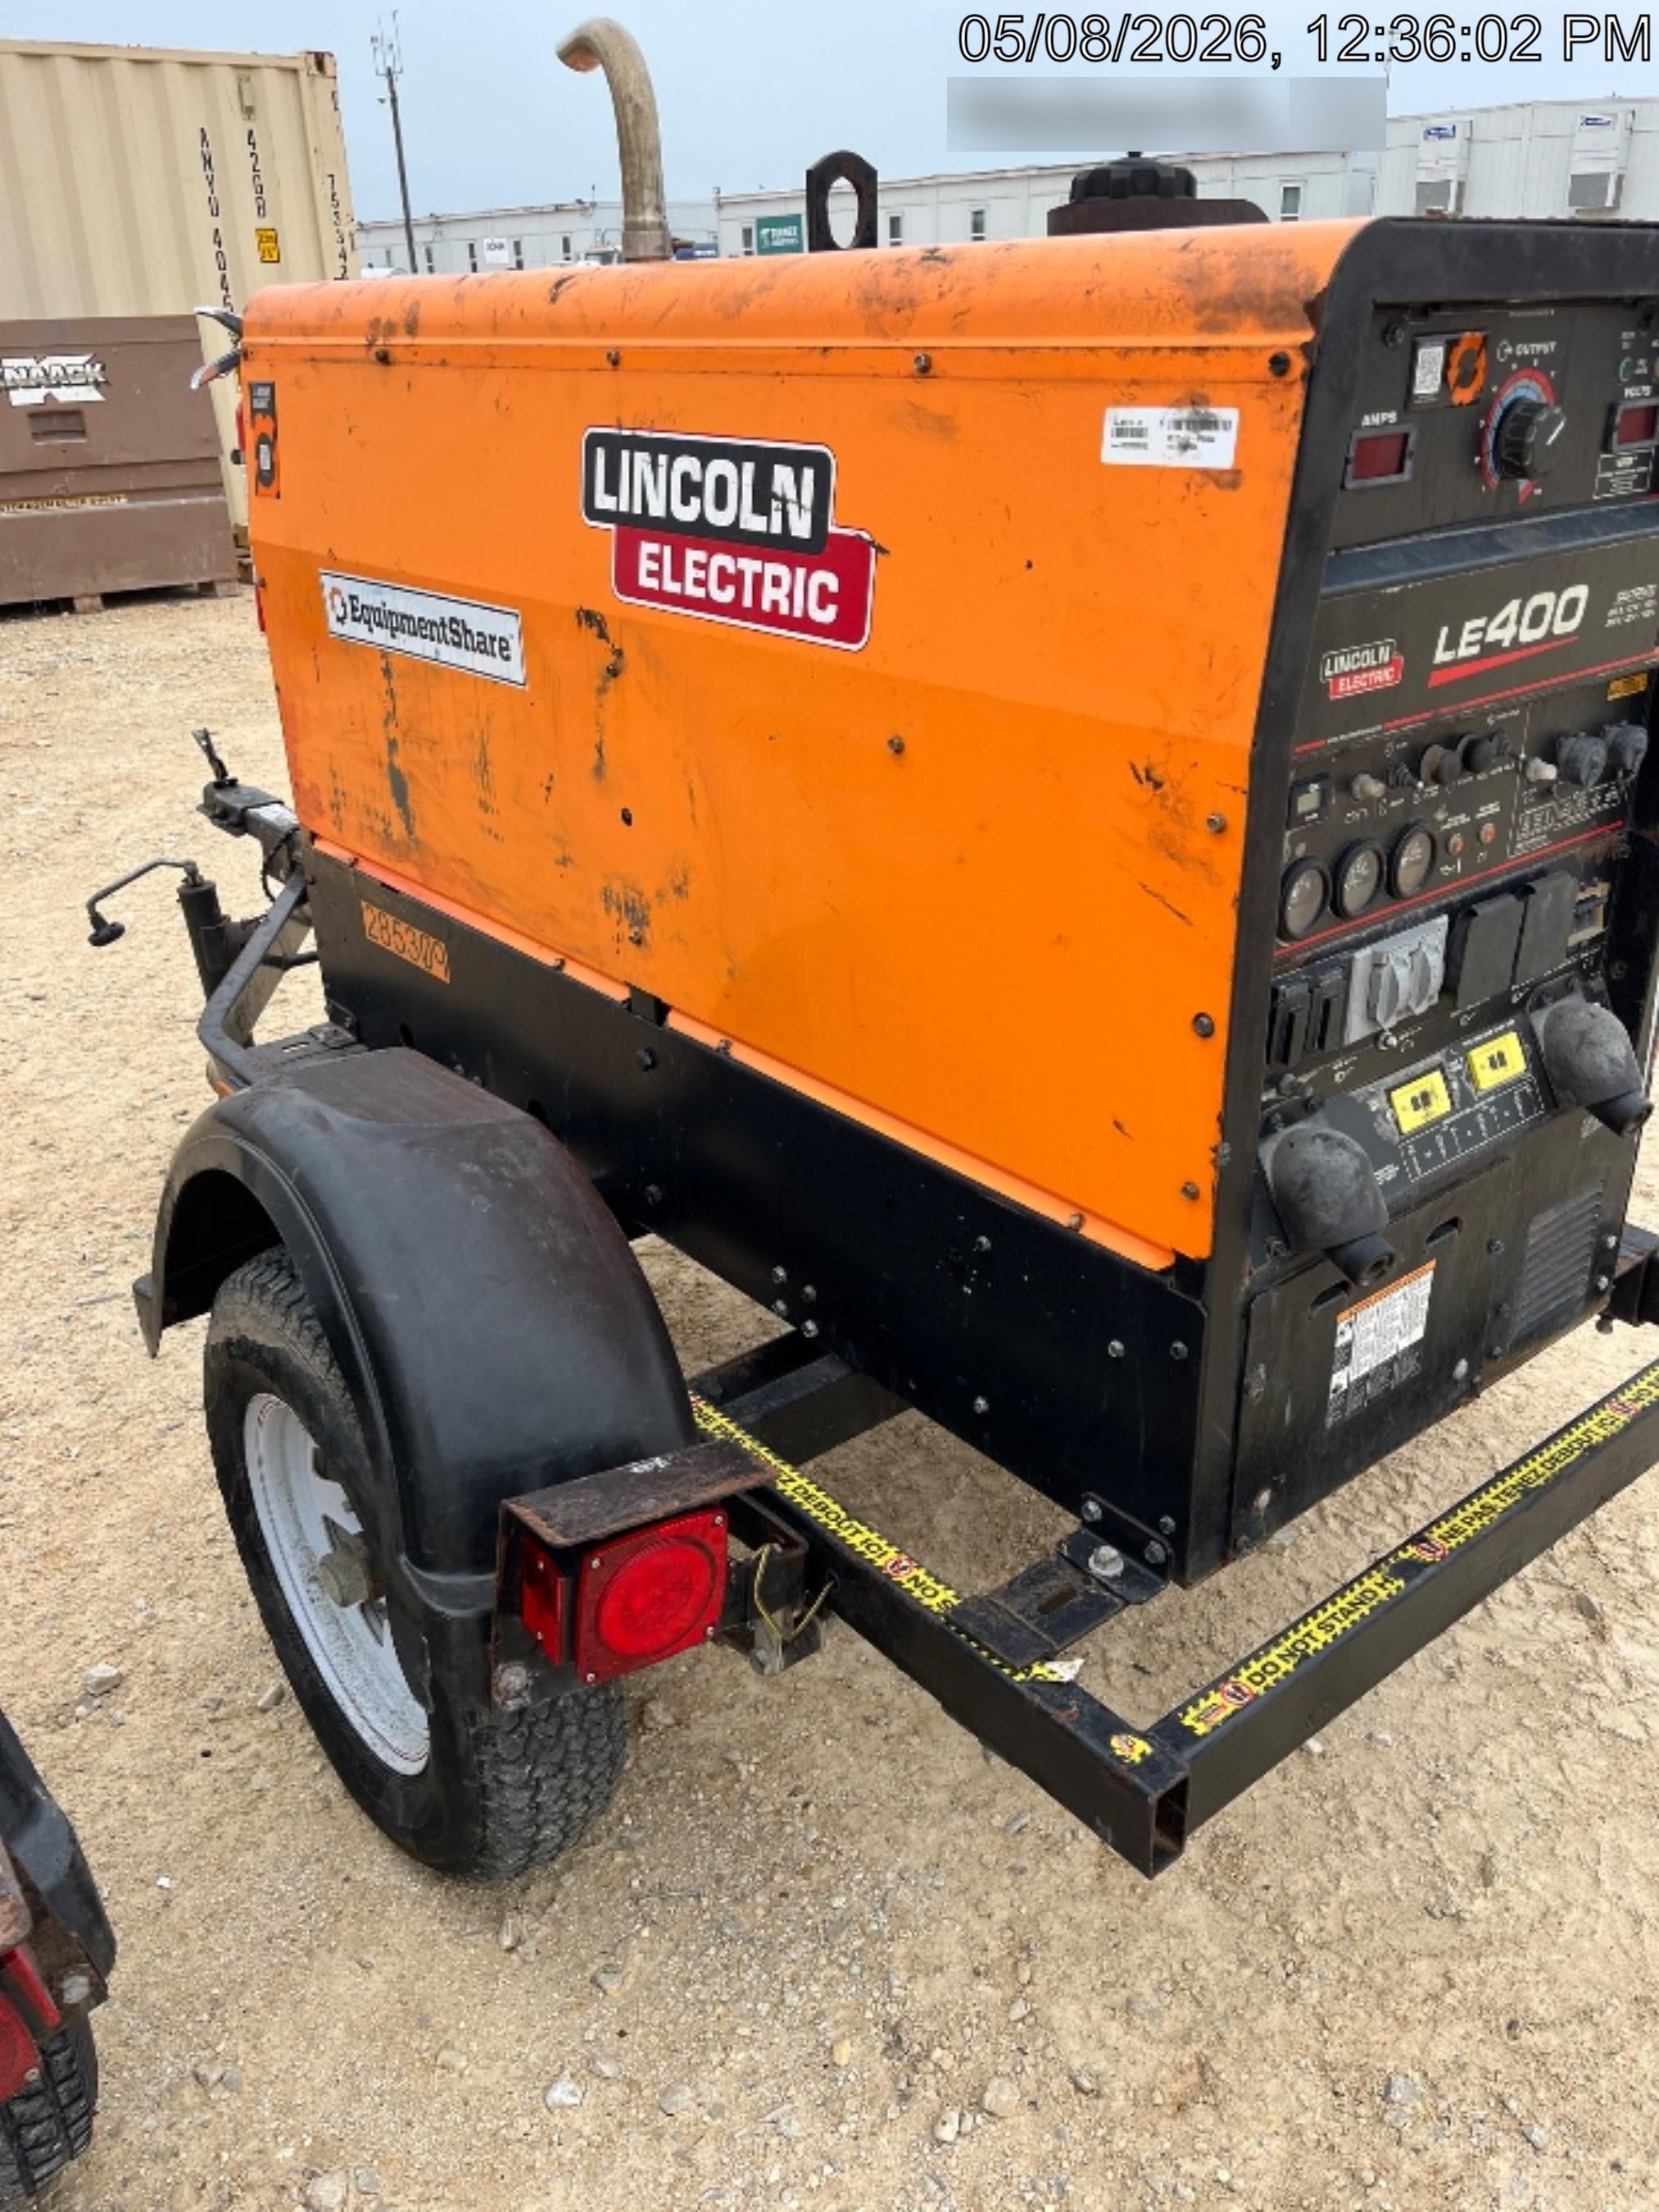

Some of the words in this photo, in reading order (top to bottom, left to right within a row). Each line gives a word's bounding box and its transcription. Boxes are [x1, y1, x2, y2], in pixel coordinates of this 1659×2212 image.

[0, 363, 108, 386] NAACK
[1362, 411, 1397, 426] AMPS
[593, 446, 814, 538] LINCOLN
[637, 540, 839, 624] ELECTRIC
[349, 594, 512, 662] EquipmentShare
[1432, 584, 1590, 665] LE400
[1325, 646, 1390, 677] LINCOLN
[1339, 668, 1394, 691] ELECTRIC
[1248, 1660, 1280, 1686] DO
[1279, 1632, 1319, 1664] NOT
[1317, 1587, 1378, 1634] STAND
